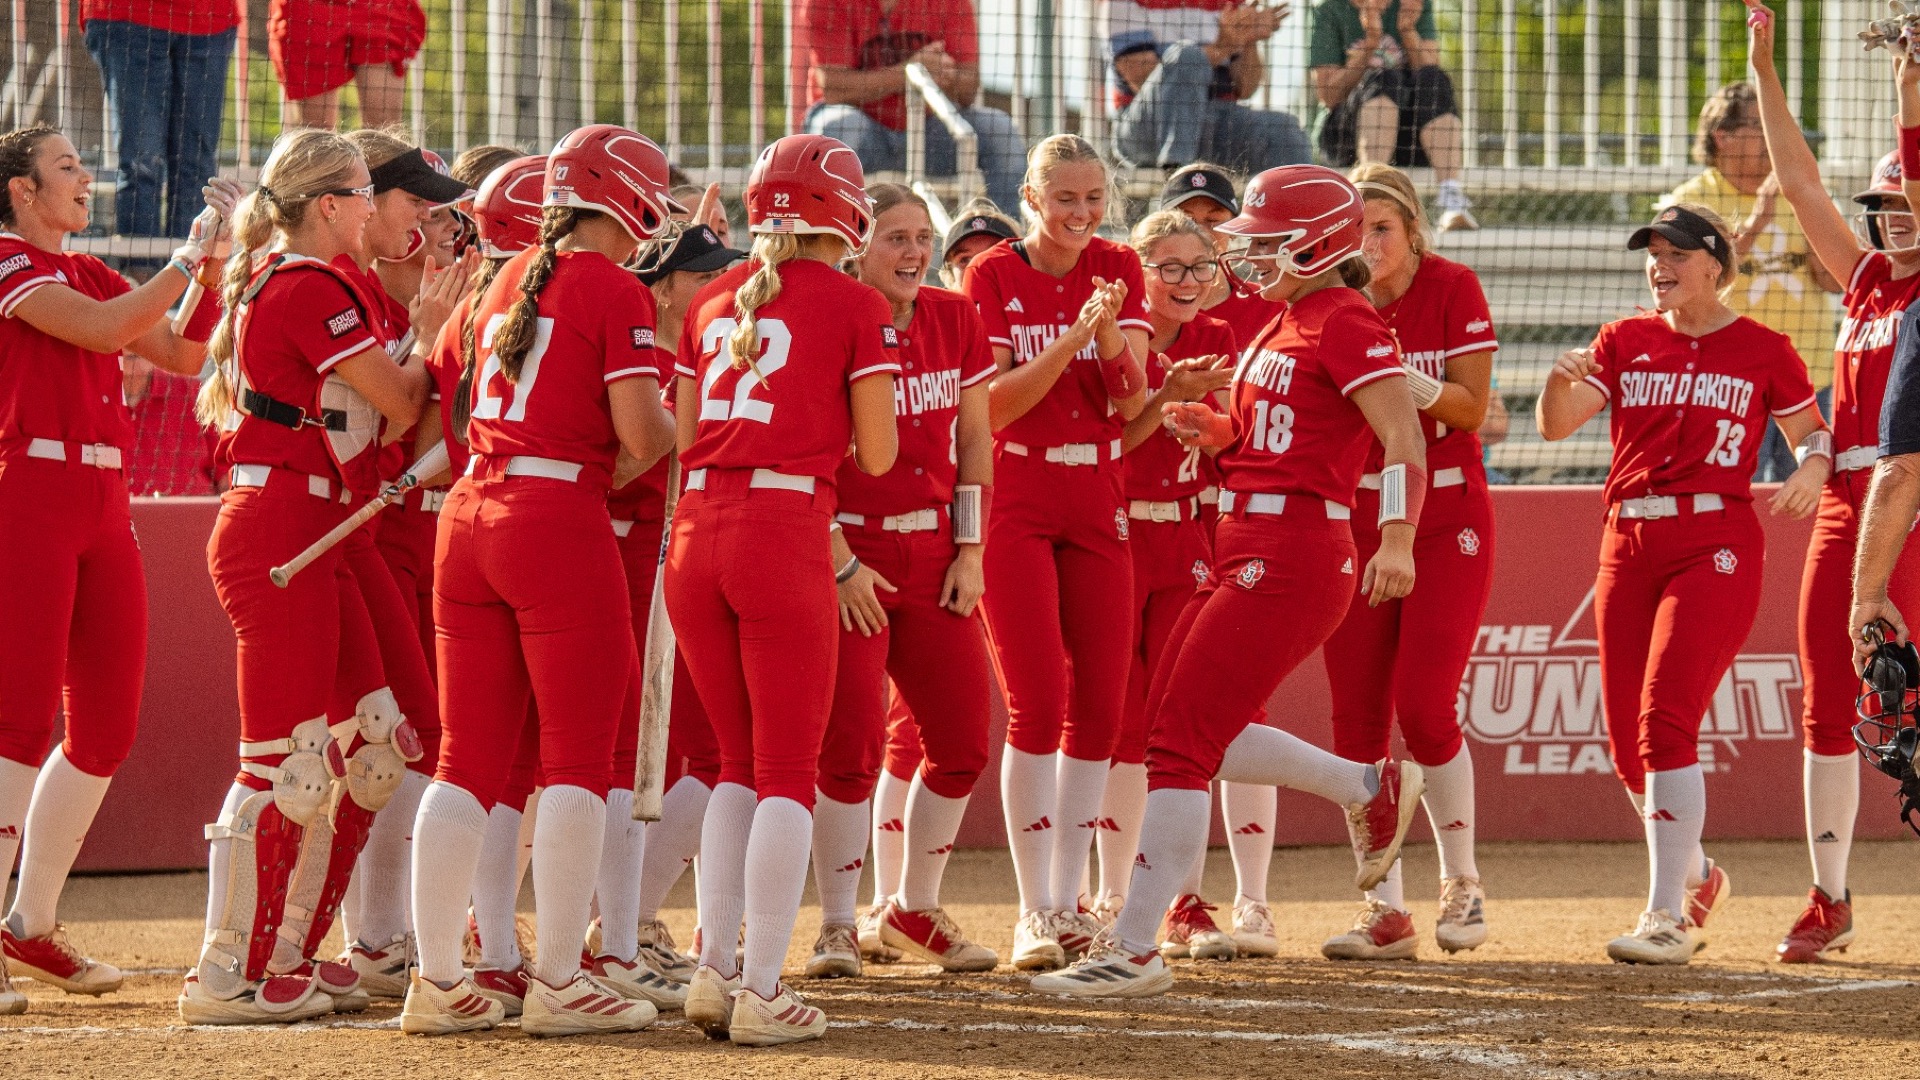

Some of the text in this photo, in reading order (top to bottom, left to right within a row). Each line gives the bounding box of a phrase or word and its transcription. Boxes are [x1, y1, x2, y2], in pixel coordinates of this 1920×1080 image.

[555, 166, 569, 181] 27
[774, 193, 790, 208] 22
[0, 253, 28, 272] OUTH
[328, 308, 357, 328] SOUTH
[1010, 324, 1055, 362] OUTH
[471, 314, 554, 422] 27
[699, 317, 793, 425] 22
[908, 368, 961, 416] DAKOT
[1620, 371, 1677, 408] SOUTH
[1253, 399, 1295, 454] 18
[1704, 419, 1747, 467] 13
[1503, 744, 1716, 774] LEAE
